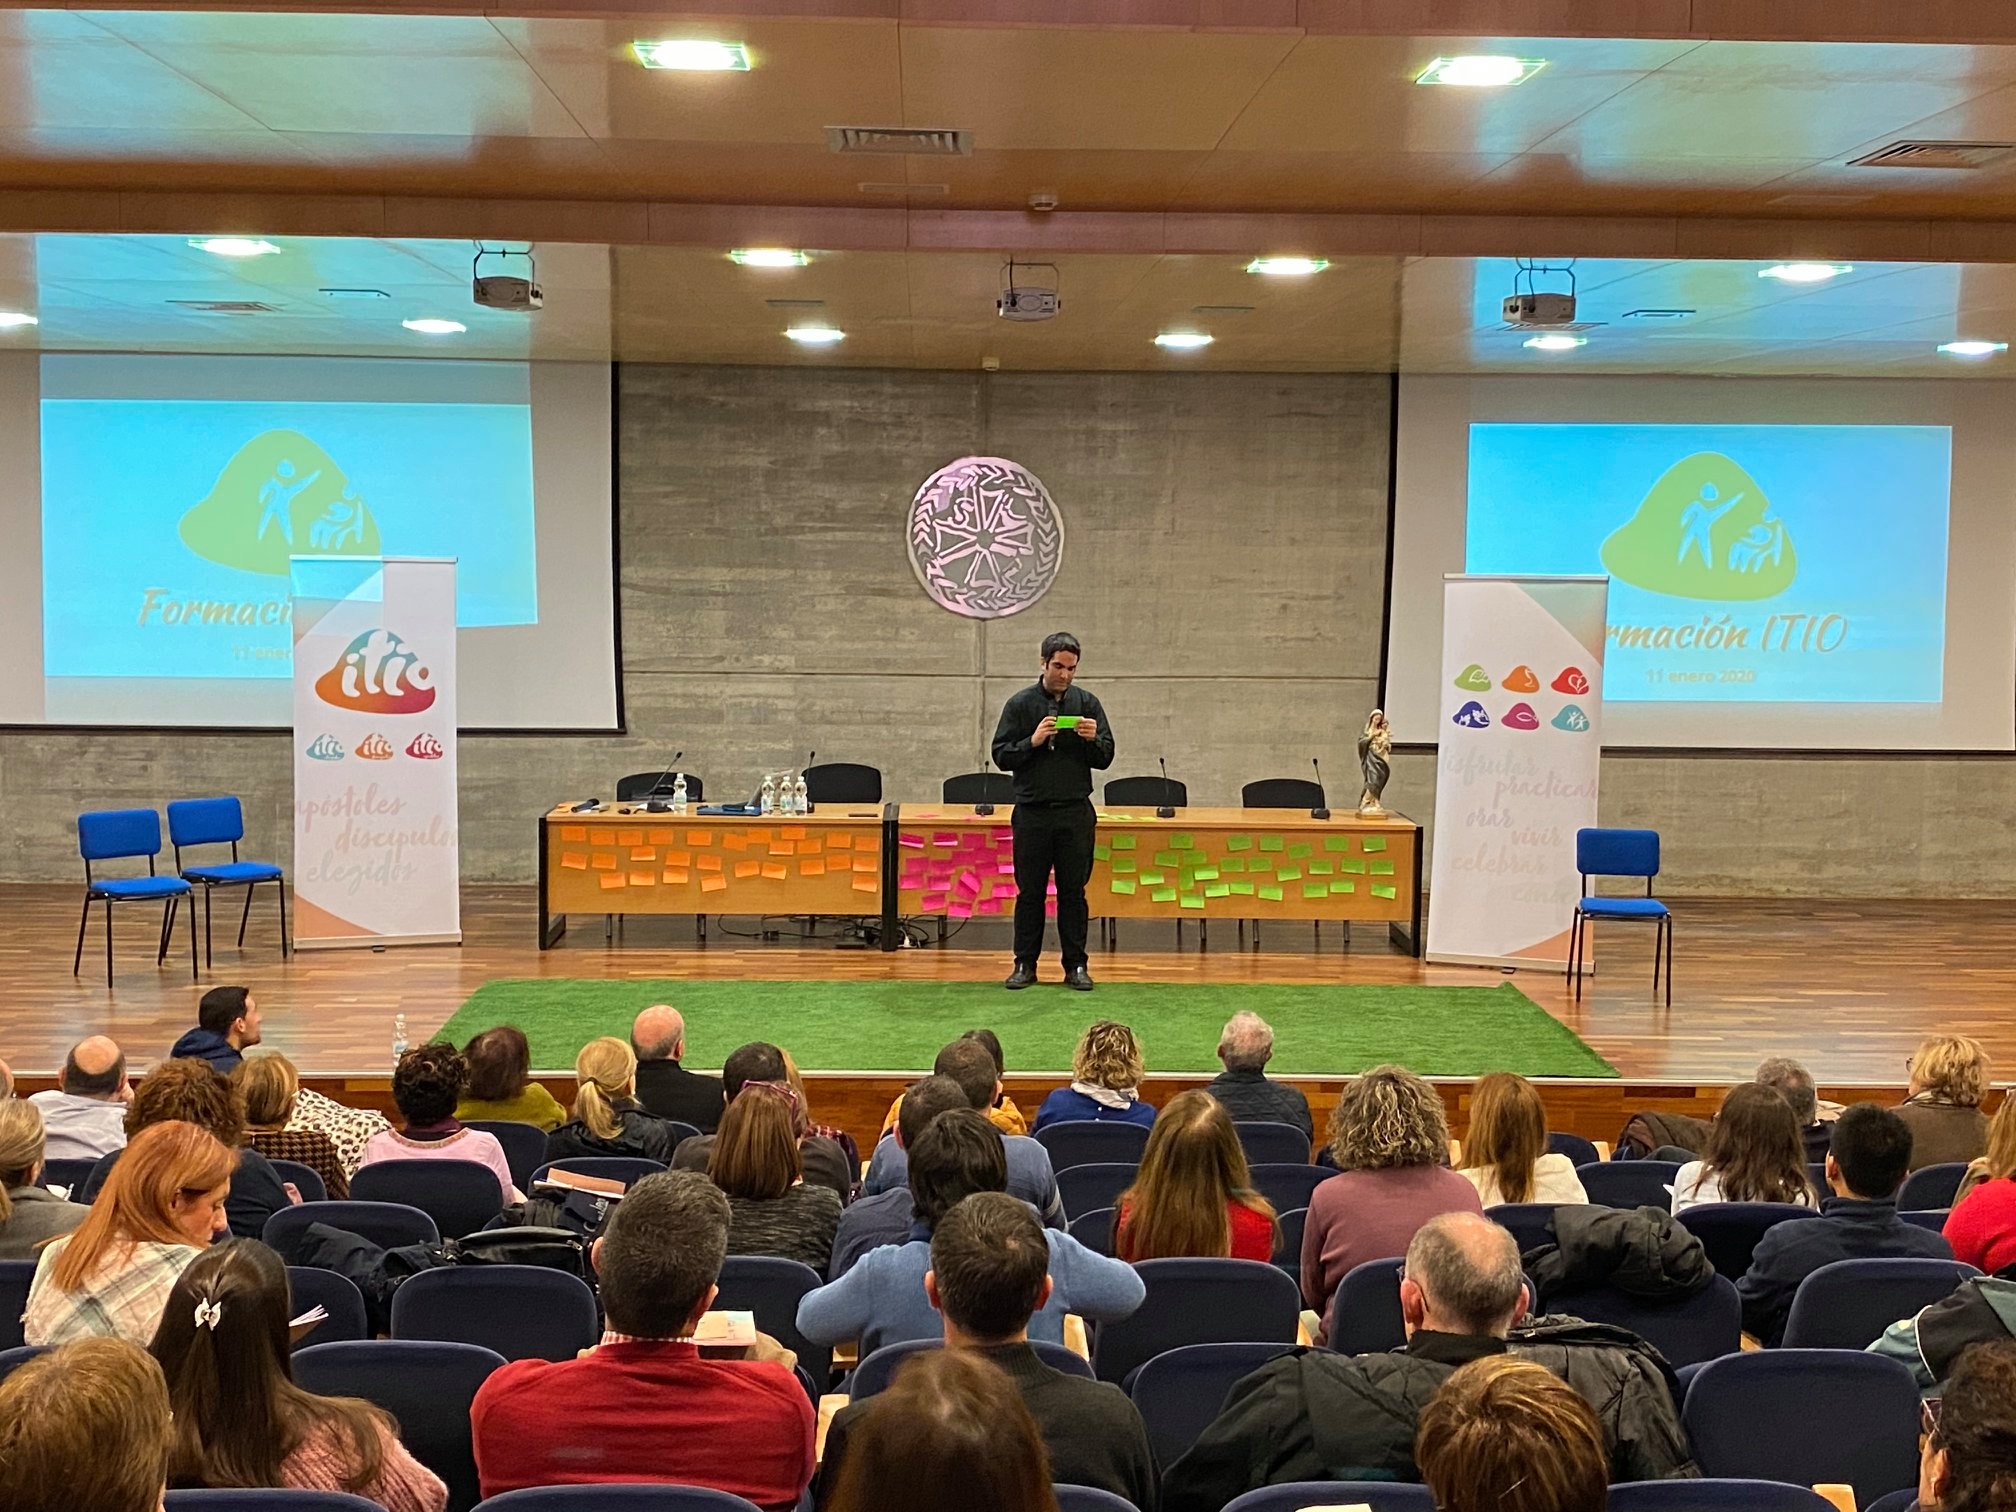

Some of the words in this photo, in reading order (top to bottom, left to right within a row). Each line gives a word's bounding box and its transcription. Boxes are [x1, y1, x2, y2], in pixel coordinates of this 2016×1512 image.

[137, 586, 292, 630] Formaci
[1605, 613, 1750, 651] rmación
[1760, 613, 1848, 653] ITIO
[254, 646, 292, 661] ener
[1646, 669, 1664, 683] 11
[1668, 670, 1716, 684] enero
[1719, 670, 1757, 684] 2020
[1466, 807, 1514, 829] orar
[1511, 826, 1562, 847] vivir
[306, 850, 417, 895] elegidos
[1452, 842, 1549, 876] celebrar
